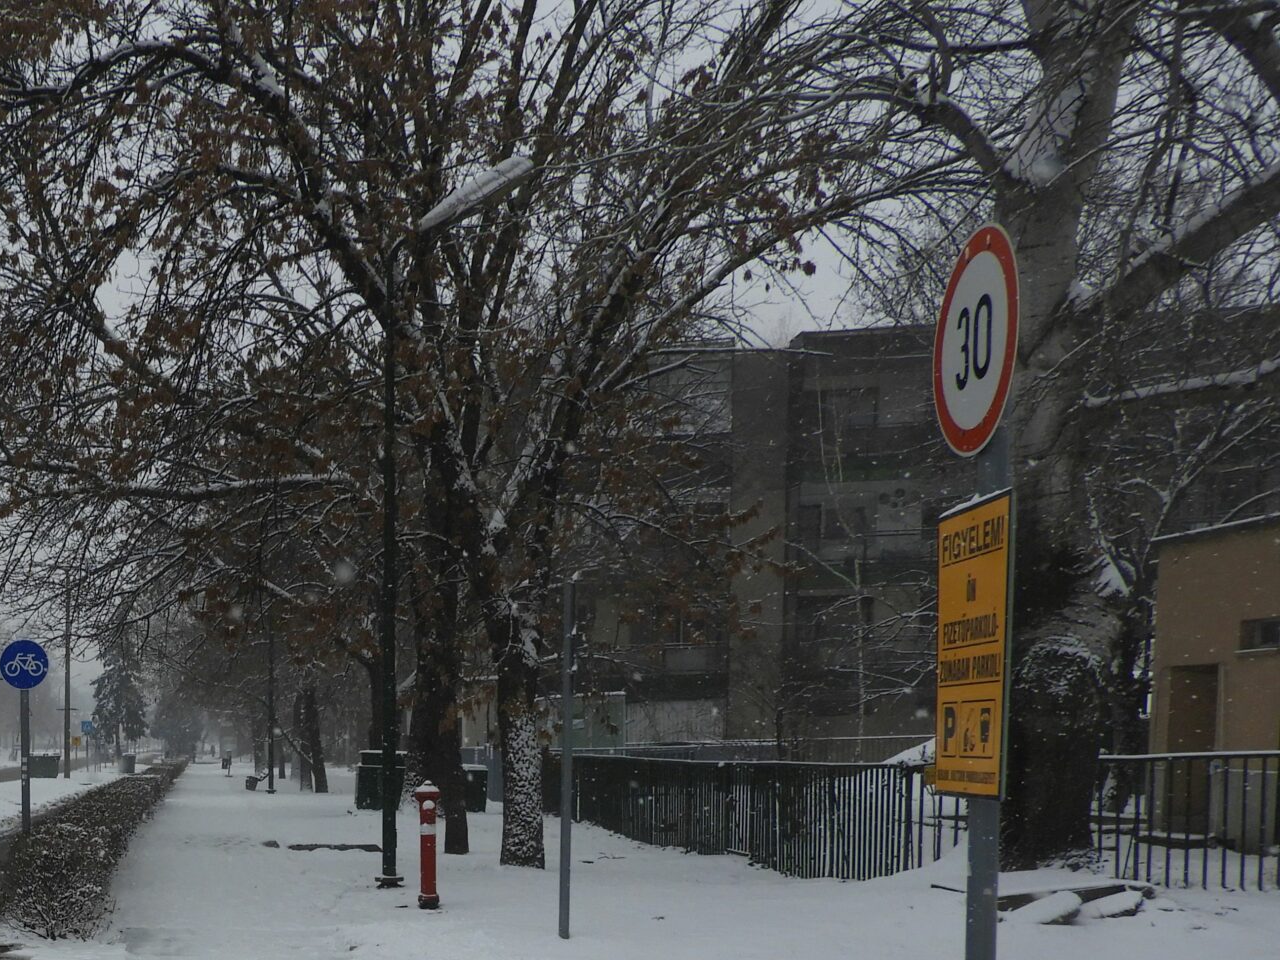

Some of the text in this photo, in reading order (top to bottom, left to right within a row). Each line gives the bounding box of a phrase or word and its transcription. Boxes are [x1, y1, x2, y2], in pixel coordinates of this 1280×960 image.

[955, 293, 992, 391] 30
[942, 515, 1004, 563] FIGYELEM!
[944, 707, 956, 752] P
